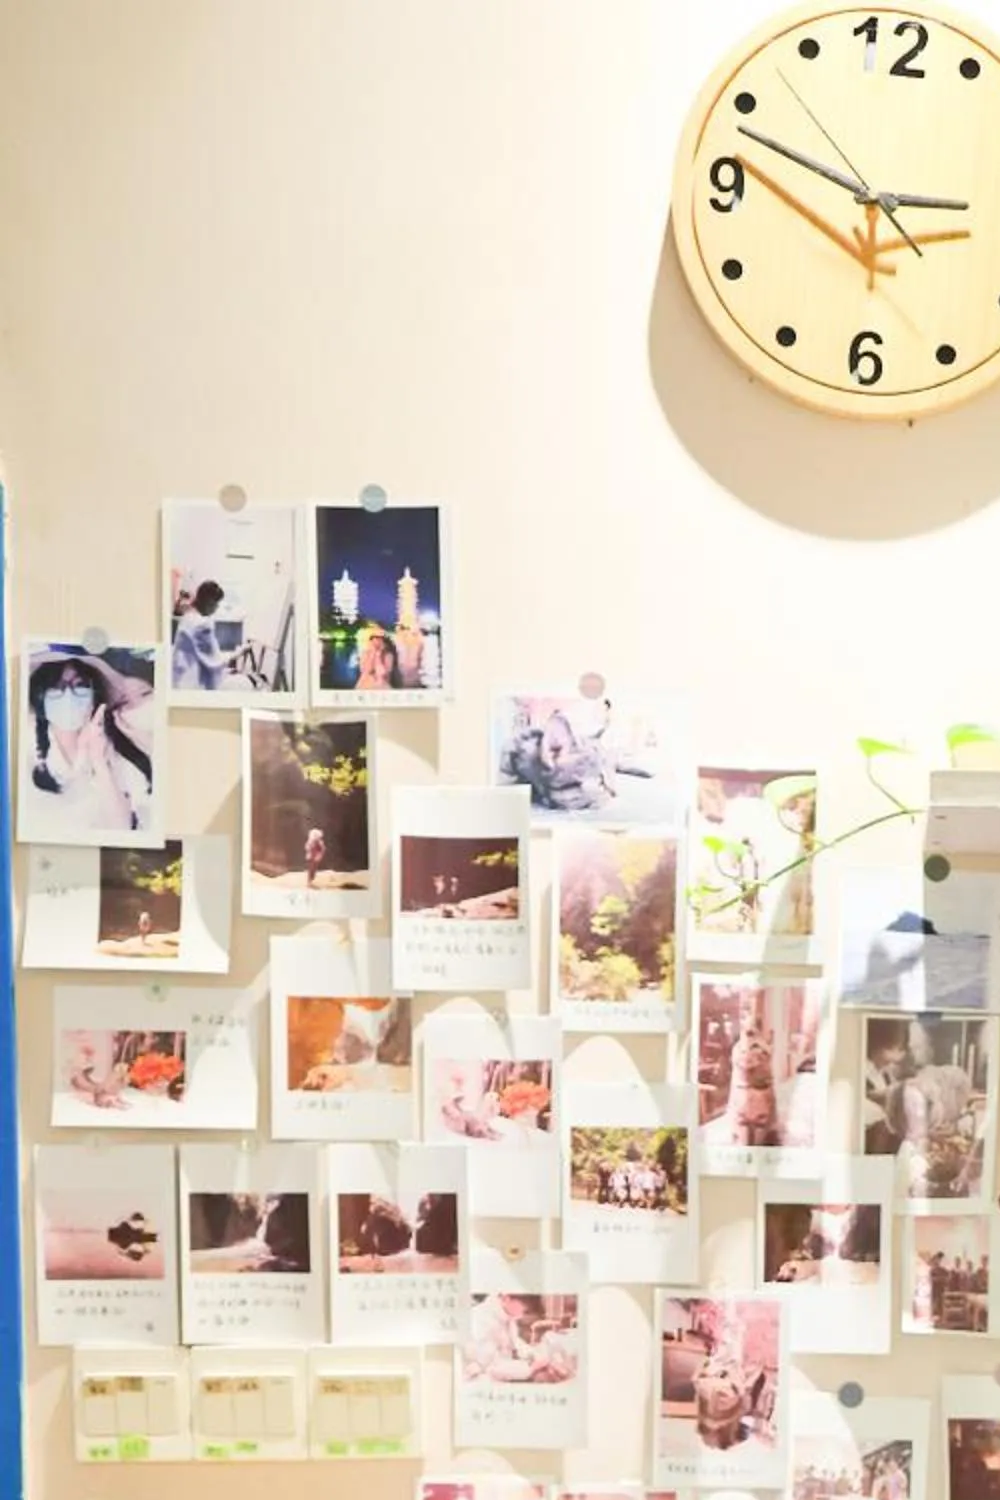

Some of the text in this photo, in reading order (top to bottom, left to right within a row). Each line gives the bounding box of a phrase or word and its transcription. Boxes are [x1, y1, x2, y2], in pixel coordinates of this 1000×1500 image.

[853, 16, 929, 79] 12
[709, 156, 745, 213] 9
[848, 330, 884, 387] 6
